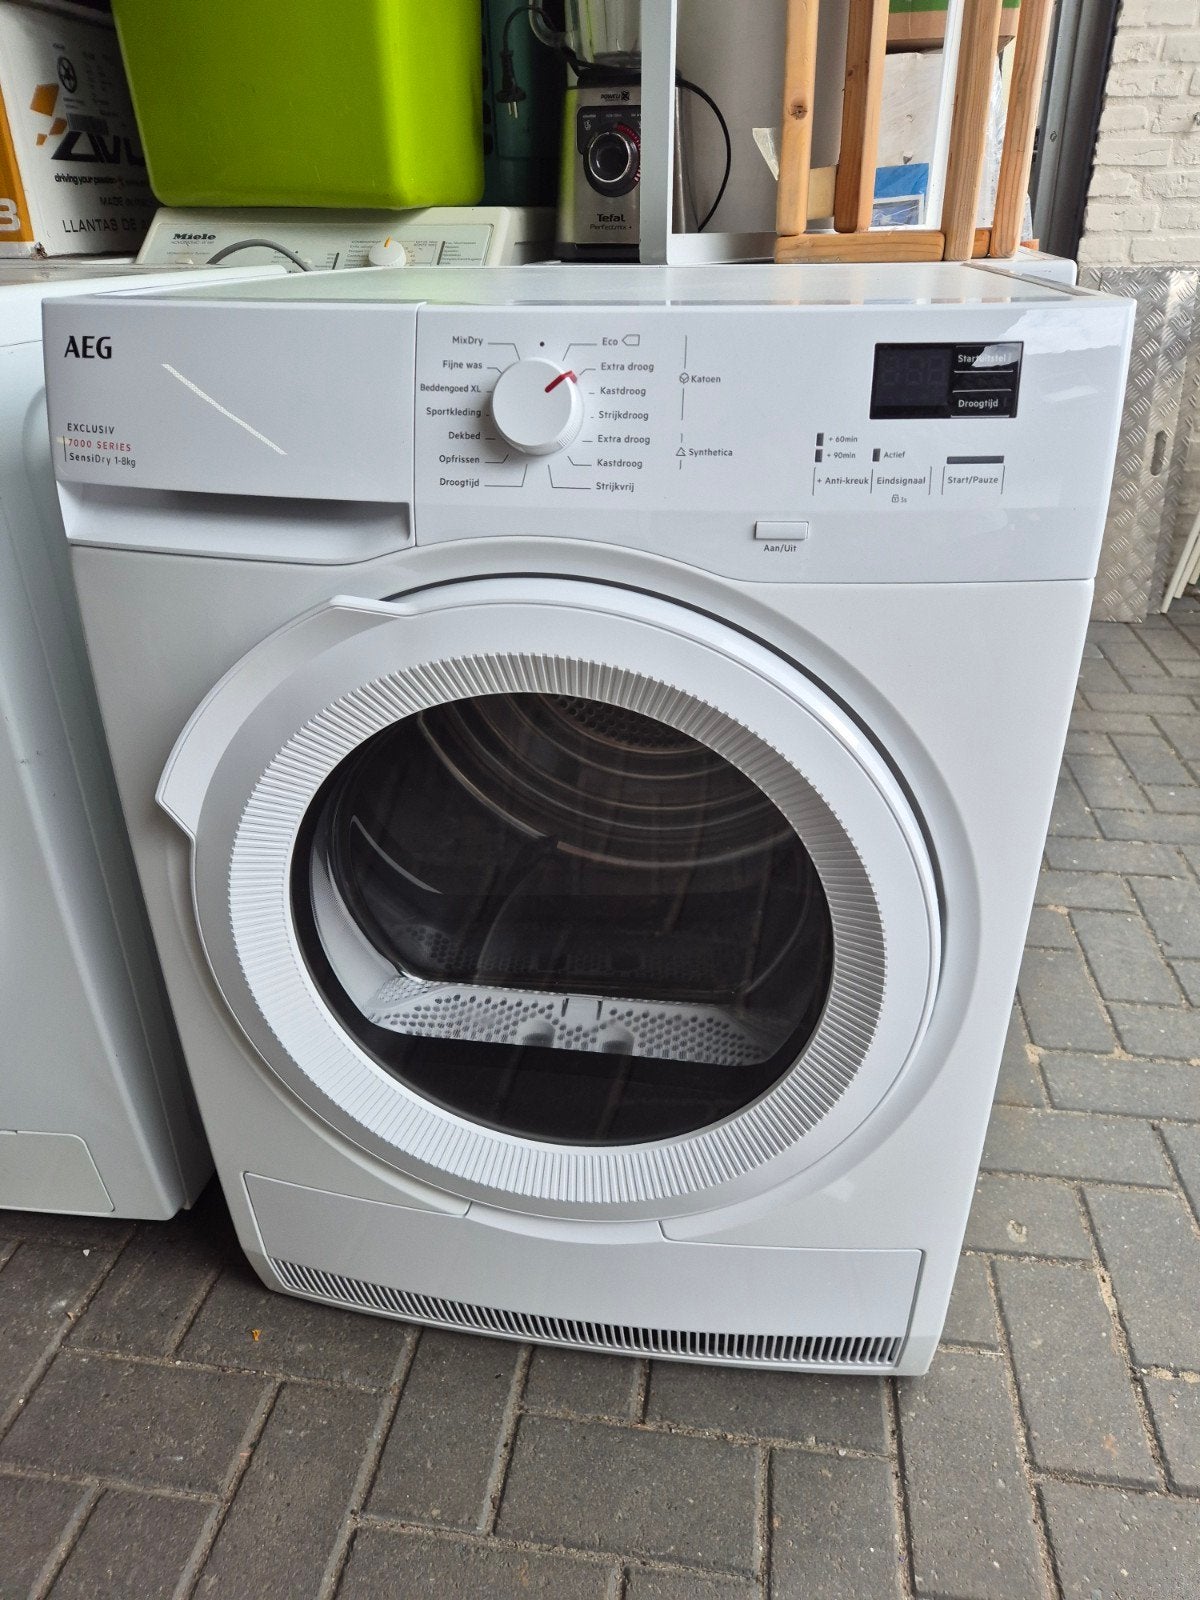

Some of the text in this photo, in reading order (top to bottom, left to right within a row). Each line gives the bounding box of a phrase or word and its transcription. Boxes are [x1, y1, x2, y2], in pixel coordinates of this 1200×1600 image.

[55, 173, 78, 185] driving
[79, 176, 92, 185] your
[597, 214, 626, 222] Tefal
[63, 219, 118, 233] LLANTAS
[173, 233, 216, 241] Miele
[452, 336, 483, 346] MixDry
[602, 337, 619, 346] Eco
[64, 336, 112, 360] AEG
[442, 360, 463, 370] Fijne
[600, 362, 654, 373] Extra droog
[691, 375, 721, 383] Katoen
[420, 383, 481, 394] Beddengoed XL
[600, 387, 647, 397] Kastdroog
[957, 398, 999, 409] Droogtijd
[426, 407, 481, 418] Sportkleding
[598, 411, 649, 422] Strijkdroog
[67, 423, 115, 435] EXCLUSIV
[448, 431, 481, 440] Dekbed
[597, 434, 651, 445] Extra droog
[835, 435, 858, 443] 60min
[68, 438, 132, 452] 7000 SERIES
[688, 448, 733, 458] Synthetica
[883, 451, 906, 459] Actief
[69, 452, 136, 468] SensiDry 1-8kg
[439, 455, 480, 464] Opfrissen
[597, 459, 643, 470] Kastdroog
[439, 478, 480, 489] Droogtijd
[825, 477, 869, 485] Anti-kreuk
[876, 477, 926, 486] Eindsignaal
[947, 476, 999, 485] Start/Pauze
[595, 482, 635, 493] Strijkvrij
[763, 544, 797, 553] Aan/Uit
